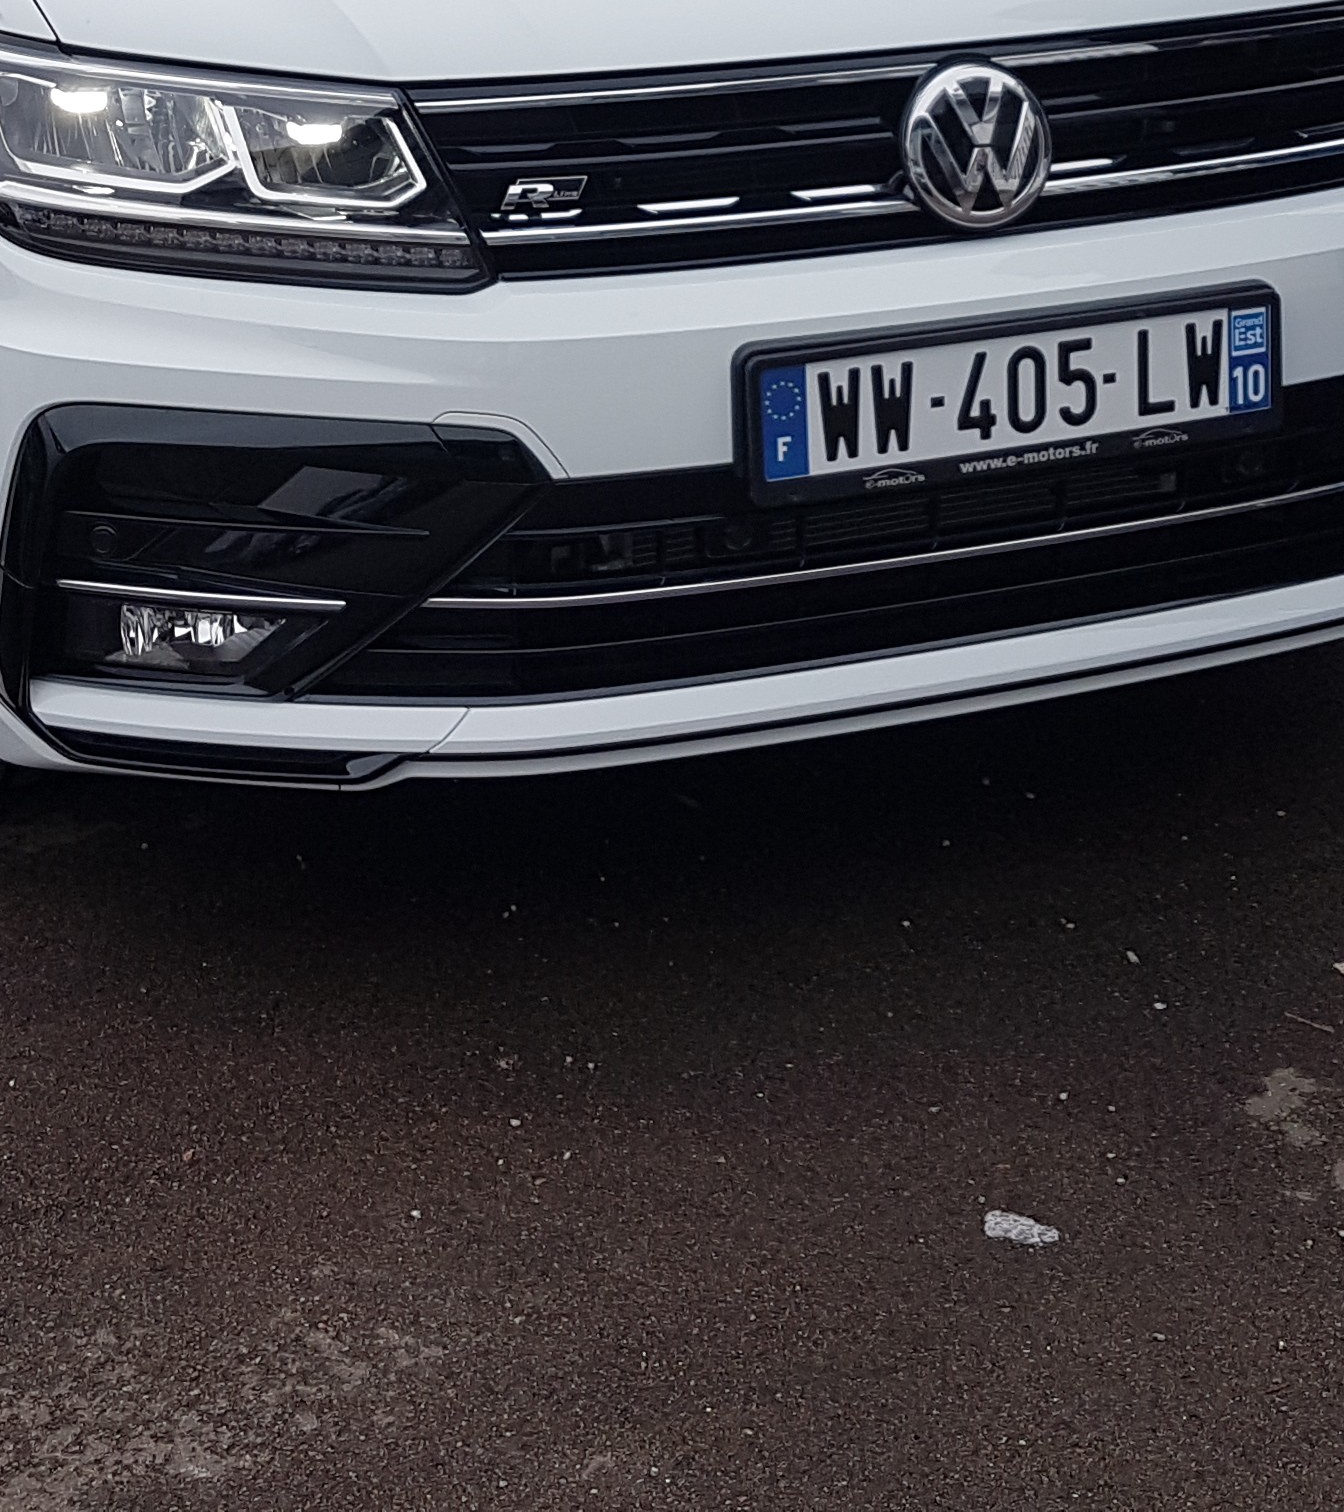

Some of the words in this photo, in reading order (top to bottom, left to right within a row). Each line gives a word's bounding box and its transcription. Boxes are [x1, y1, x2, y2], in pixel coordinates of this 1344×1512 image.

[1234, 315, 1264, 328] Grand
[1234, 327, 1264, 346] Est
[817, 319, 1223, 462] WW-405-LW
[1232, 364, 1266, 405] 10
[777, 436, 792, 462] F
[959, 440, 1099, 474] www.e-motors.fr
